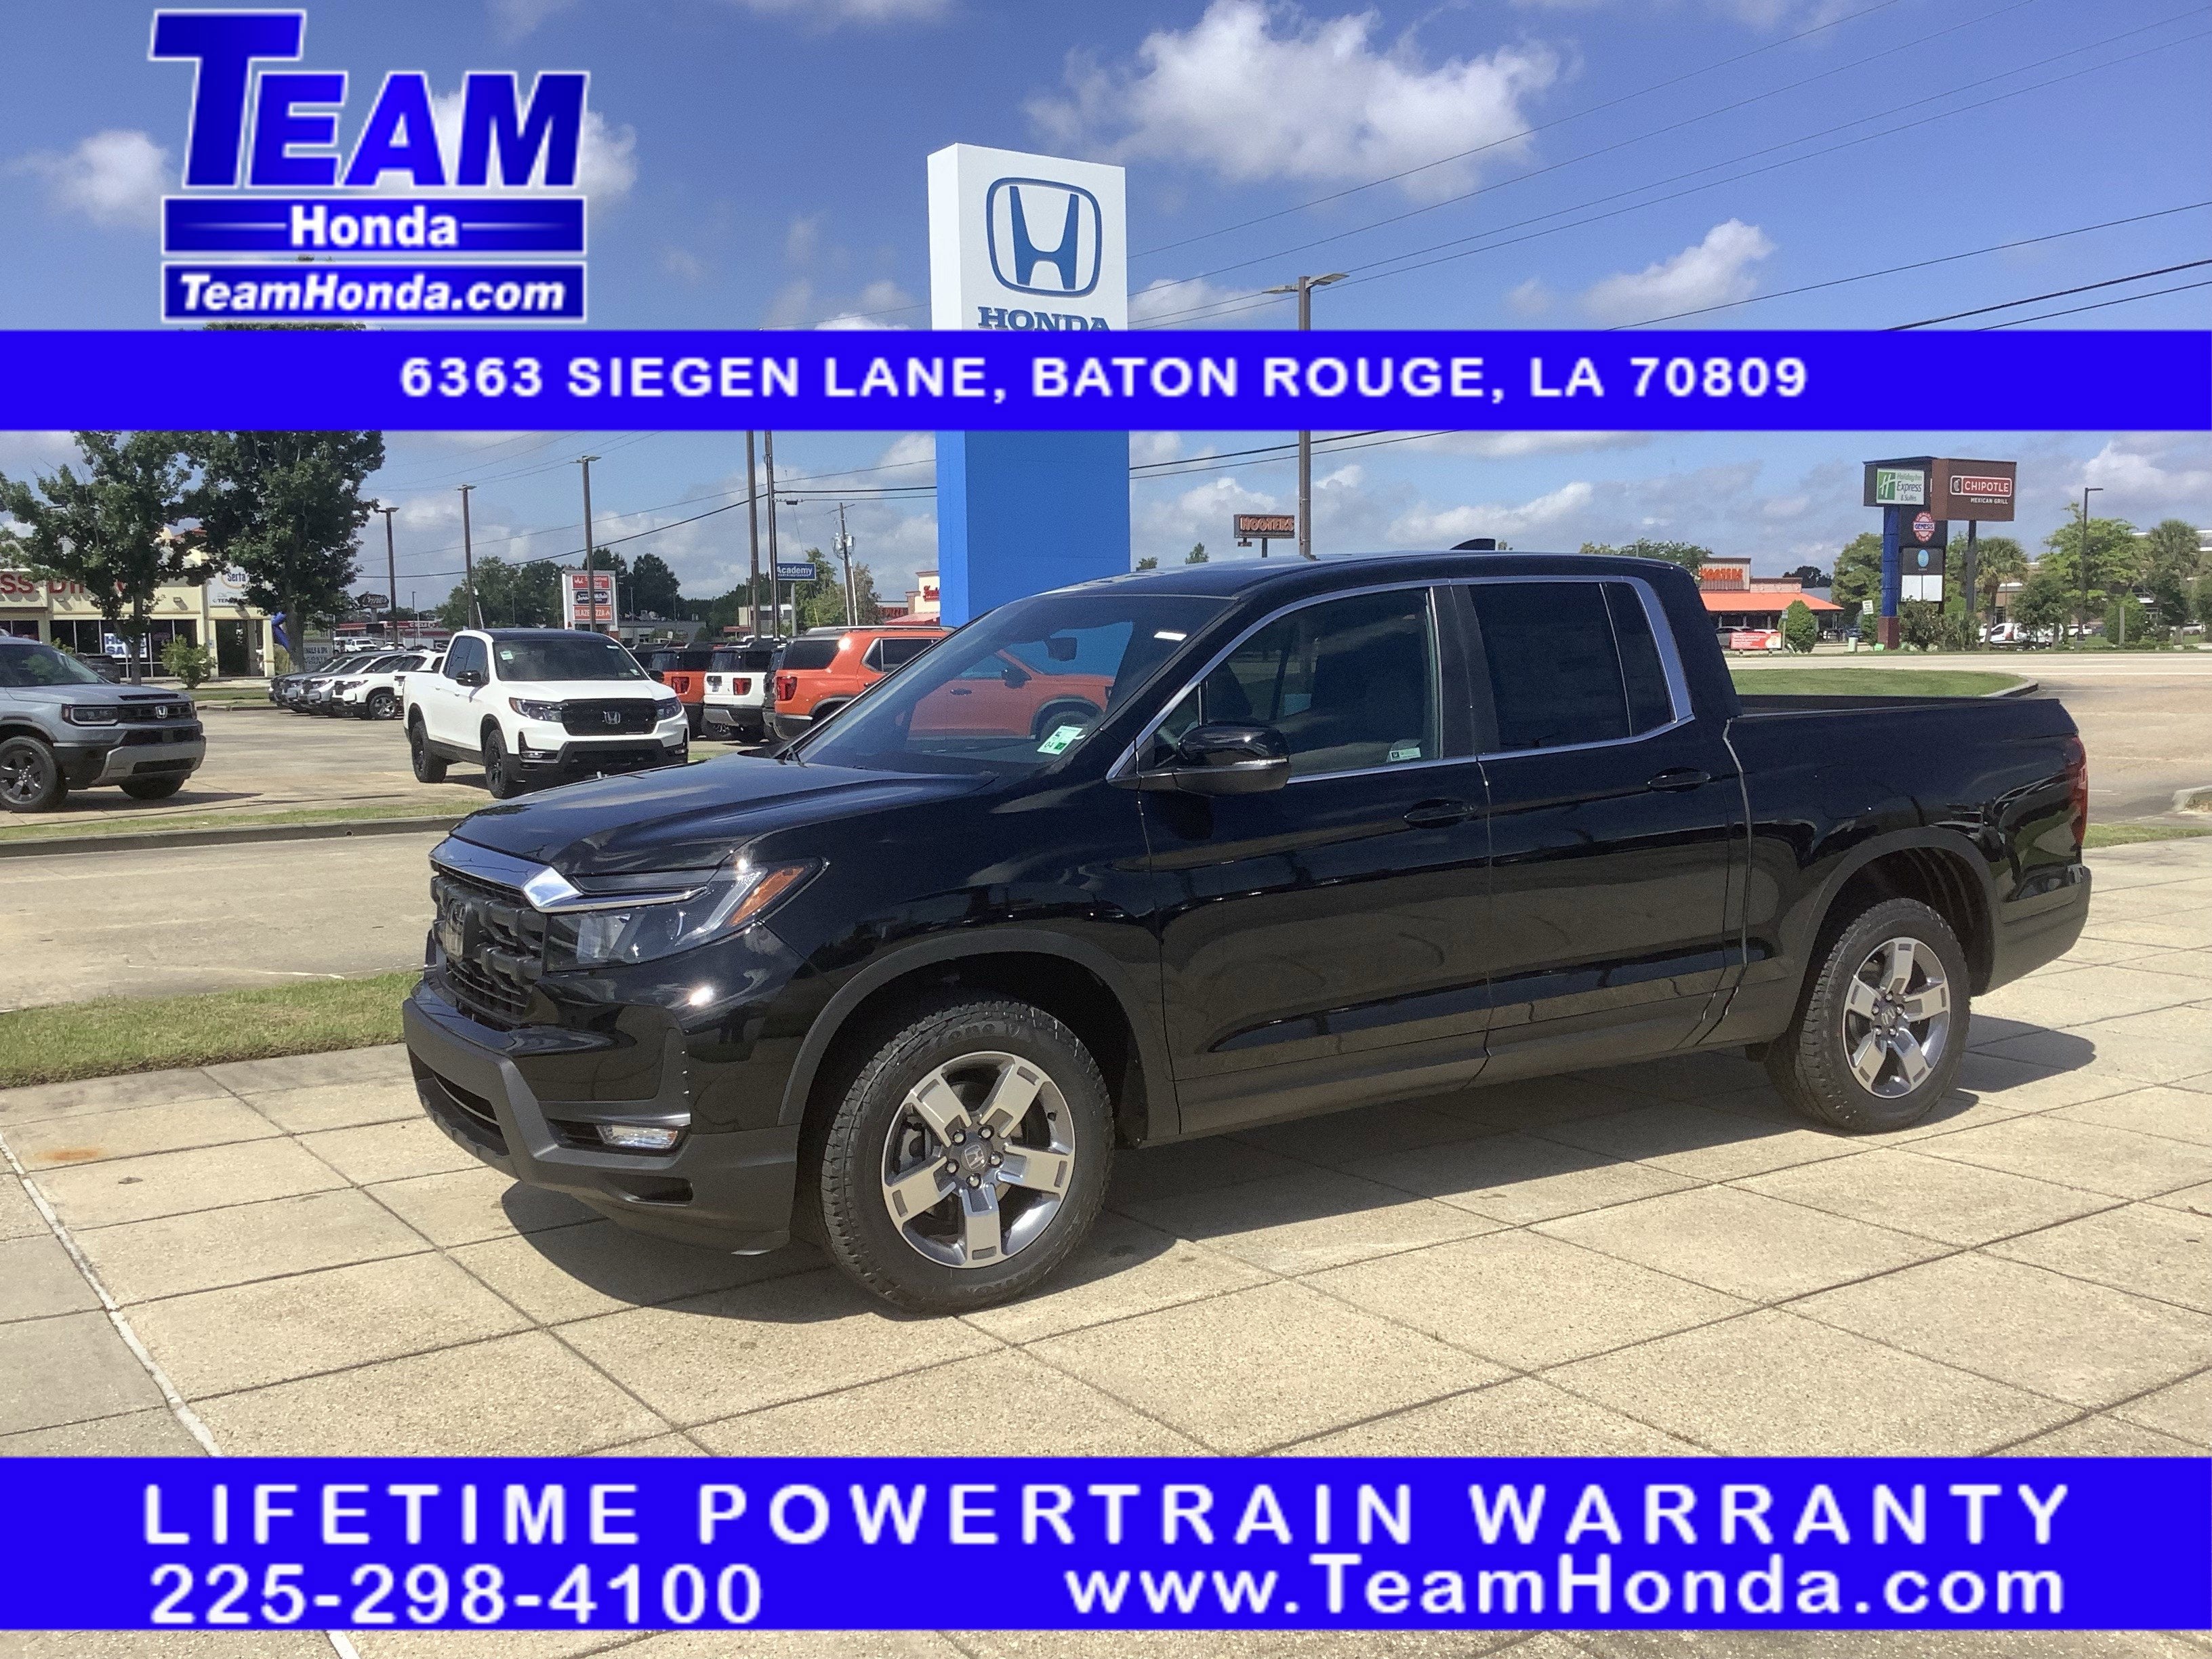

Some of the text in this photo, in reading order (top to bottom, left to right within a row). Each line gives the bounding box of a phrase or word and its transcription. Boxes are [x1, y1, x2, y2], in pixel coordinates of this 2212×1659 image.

[977, 306, 1111, 330] HONDA
[1897, 480, 1923, 493] Express
[1965, 480, 2009, 492] CHIPOTLE
[1240, 517, 1294, 531] HOOTERS
[228, 572, 246, 582] Serta
[777, 566, 813, 576] Academy
